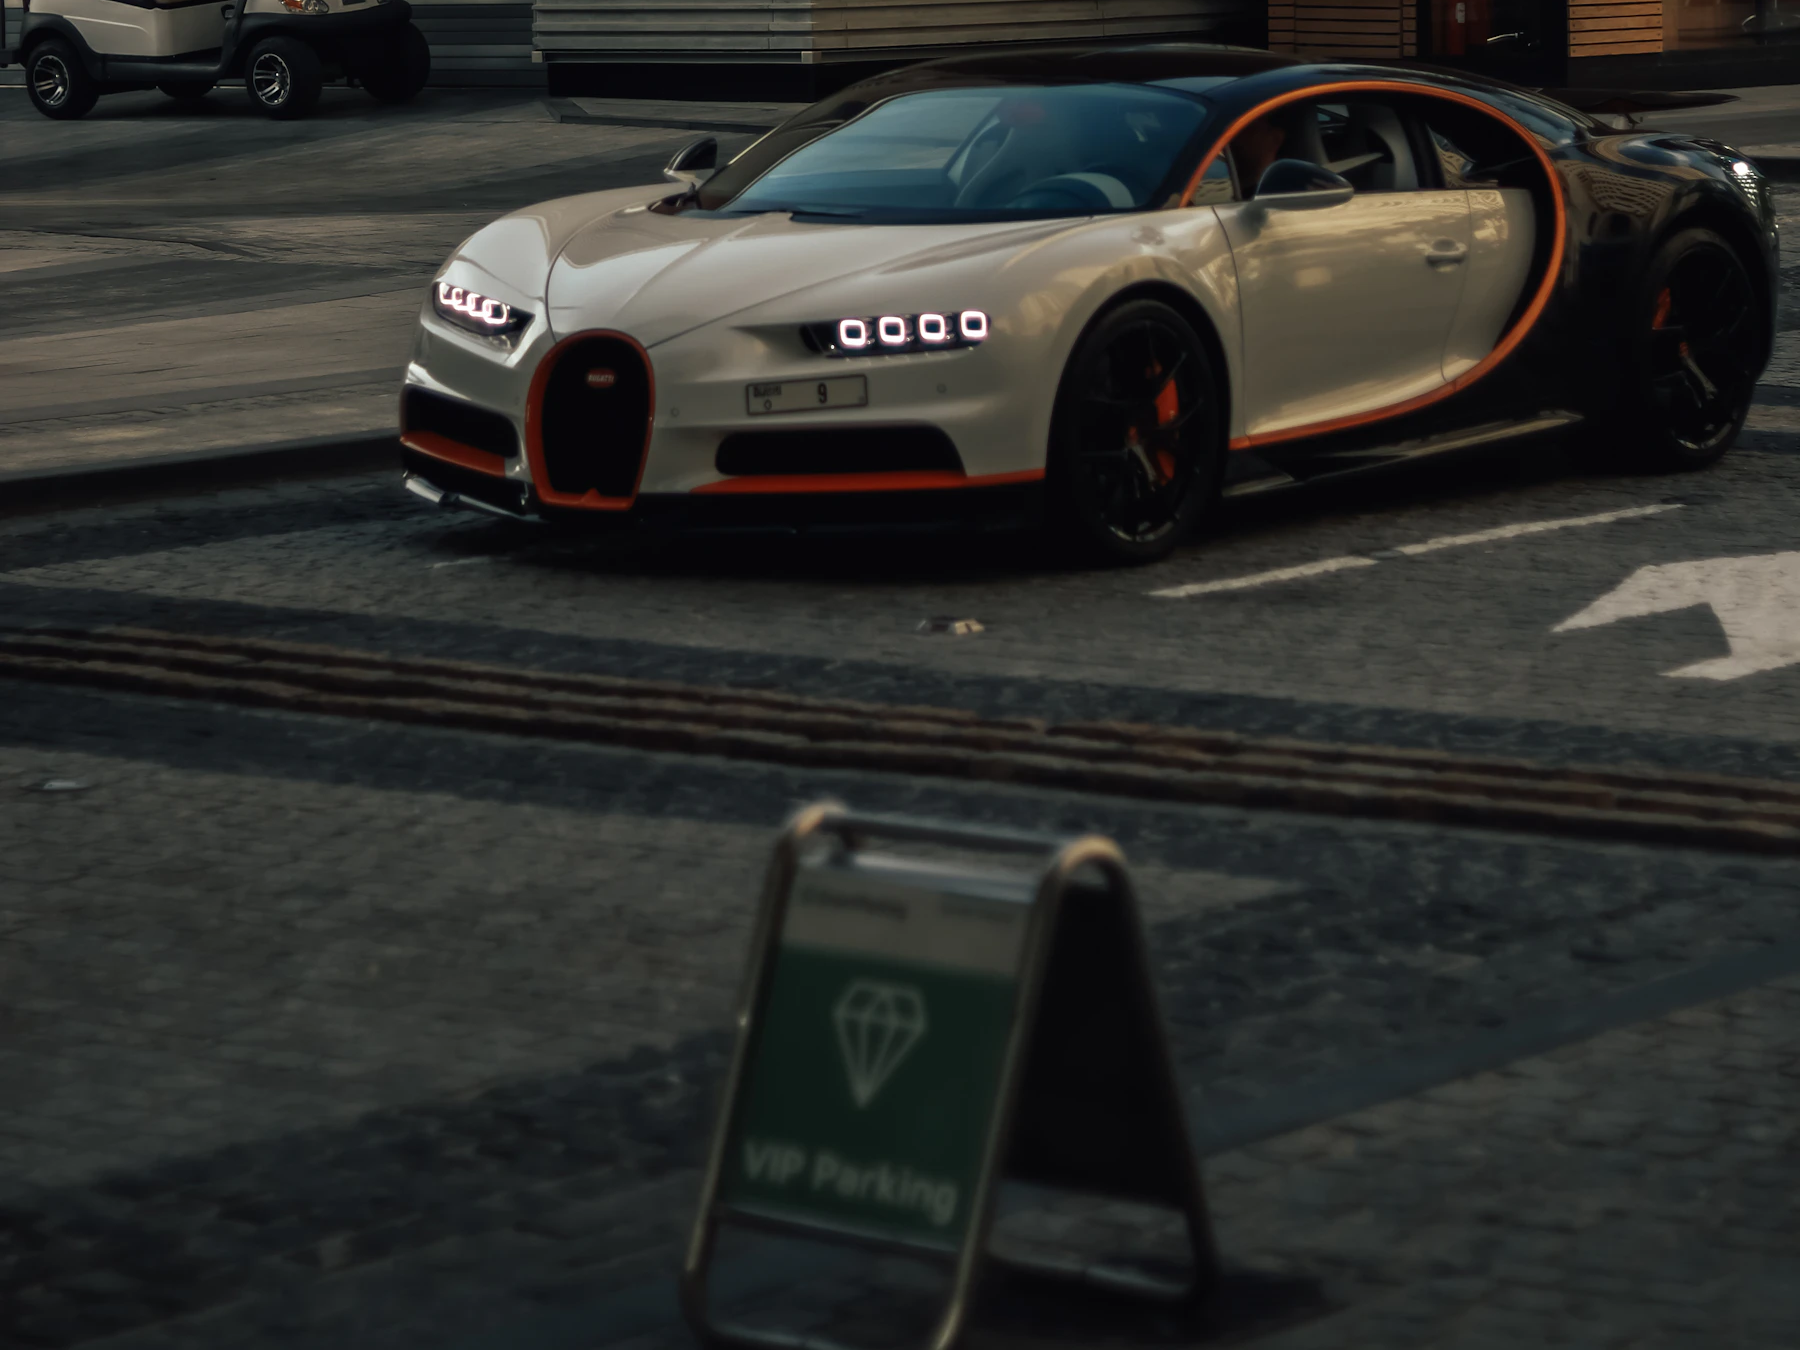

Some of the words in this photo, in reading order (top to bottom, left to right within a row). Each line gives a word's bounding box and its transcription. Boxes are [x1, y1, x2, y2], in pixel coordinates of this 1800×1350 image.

[817, 383, 828, 404] 9
[743, 1139, 807, 1185] VIP
[810, 1150, 960, 1226] Parking
